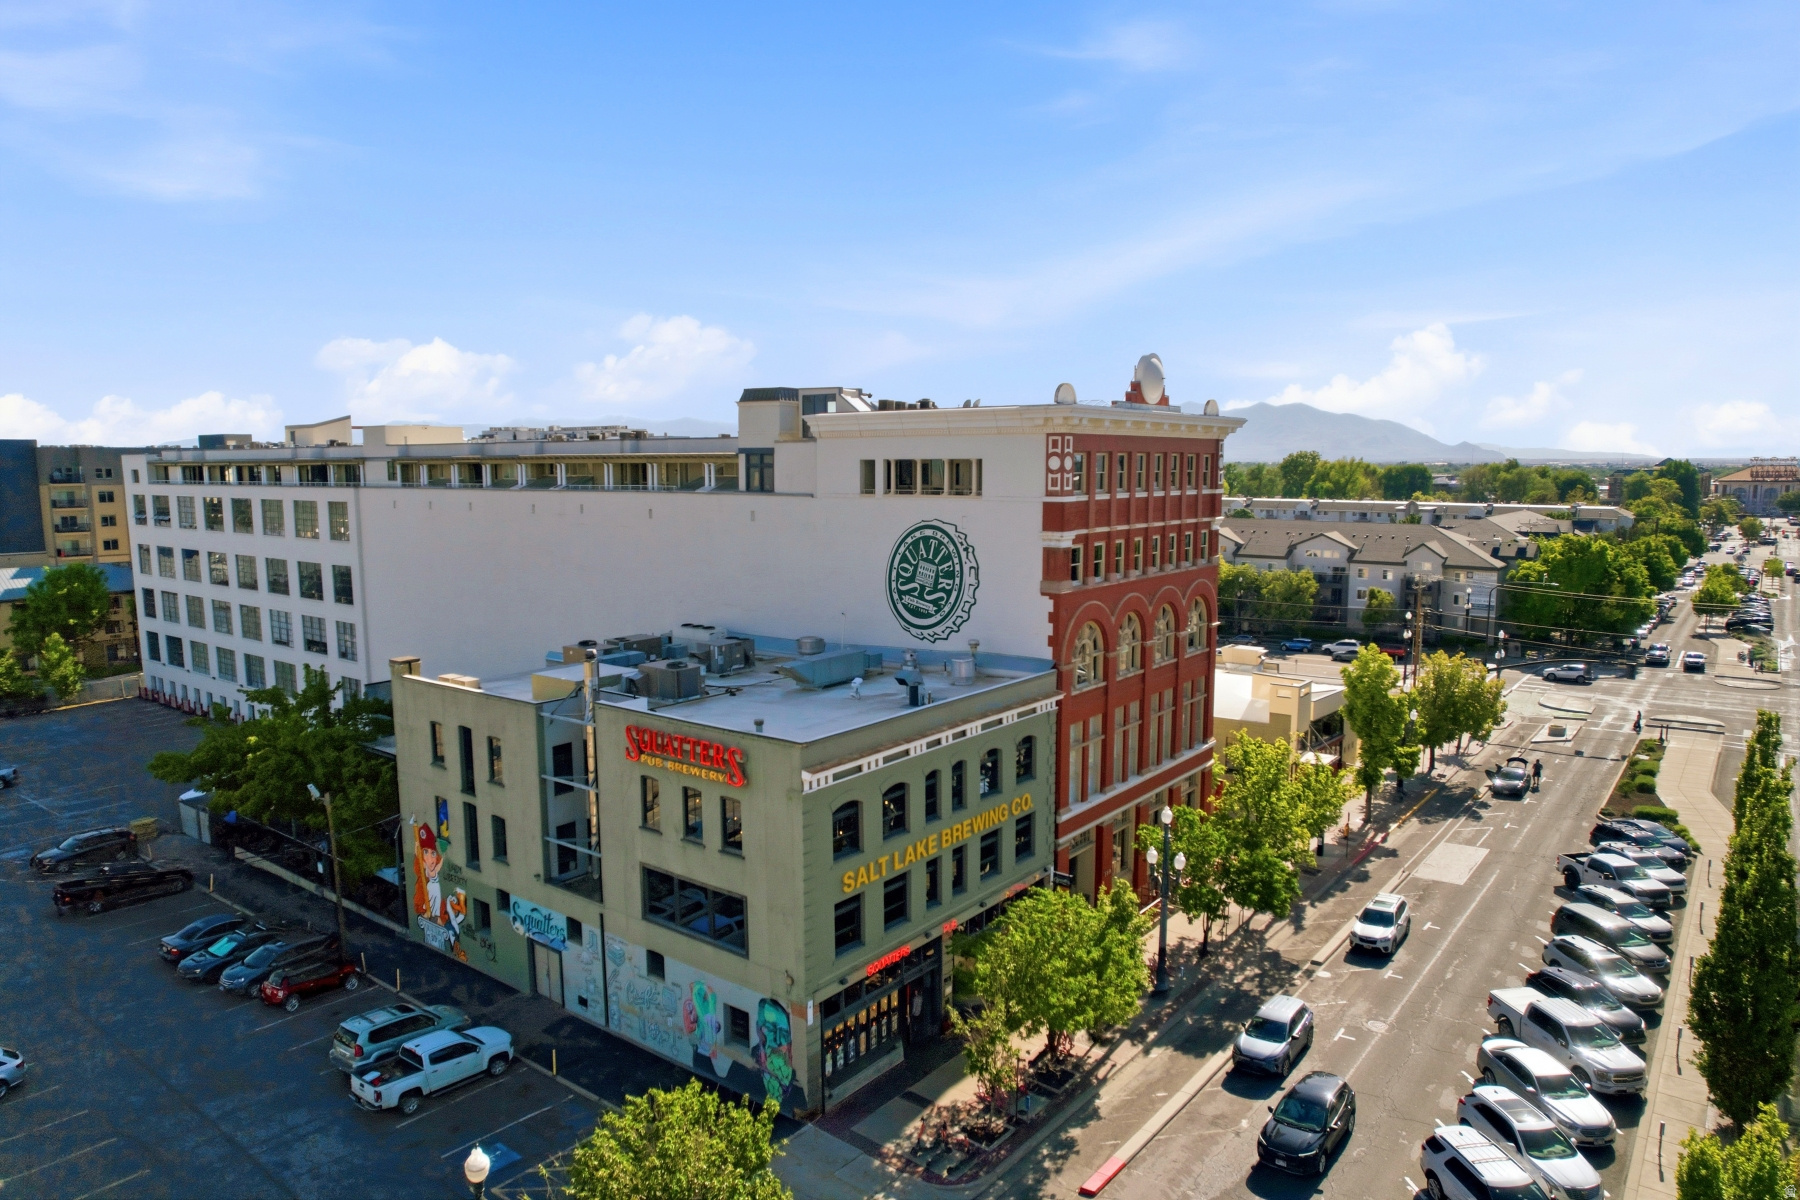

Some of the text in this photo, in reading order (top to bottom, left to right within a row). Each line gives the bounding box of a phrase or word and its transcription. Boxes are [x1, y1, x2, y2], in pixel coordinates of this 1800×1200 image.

[897, 539, 954, 606] SQUATTERS
[932, 531, 959, 592] BREWING
[625, 724, 745, 787] SQUATTERS
[640, 753, 728, 783] PUB BREWERY
[842, 793, 1034, 894] SALT LAKE BREWING CO.
[512, 901, 567, 944] Squatters
[866, 945, 911, 977] SQUATTERS
